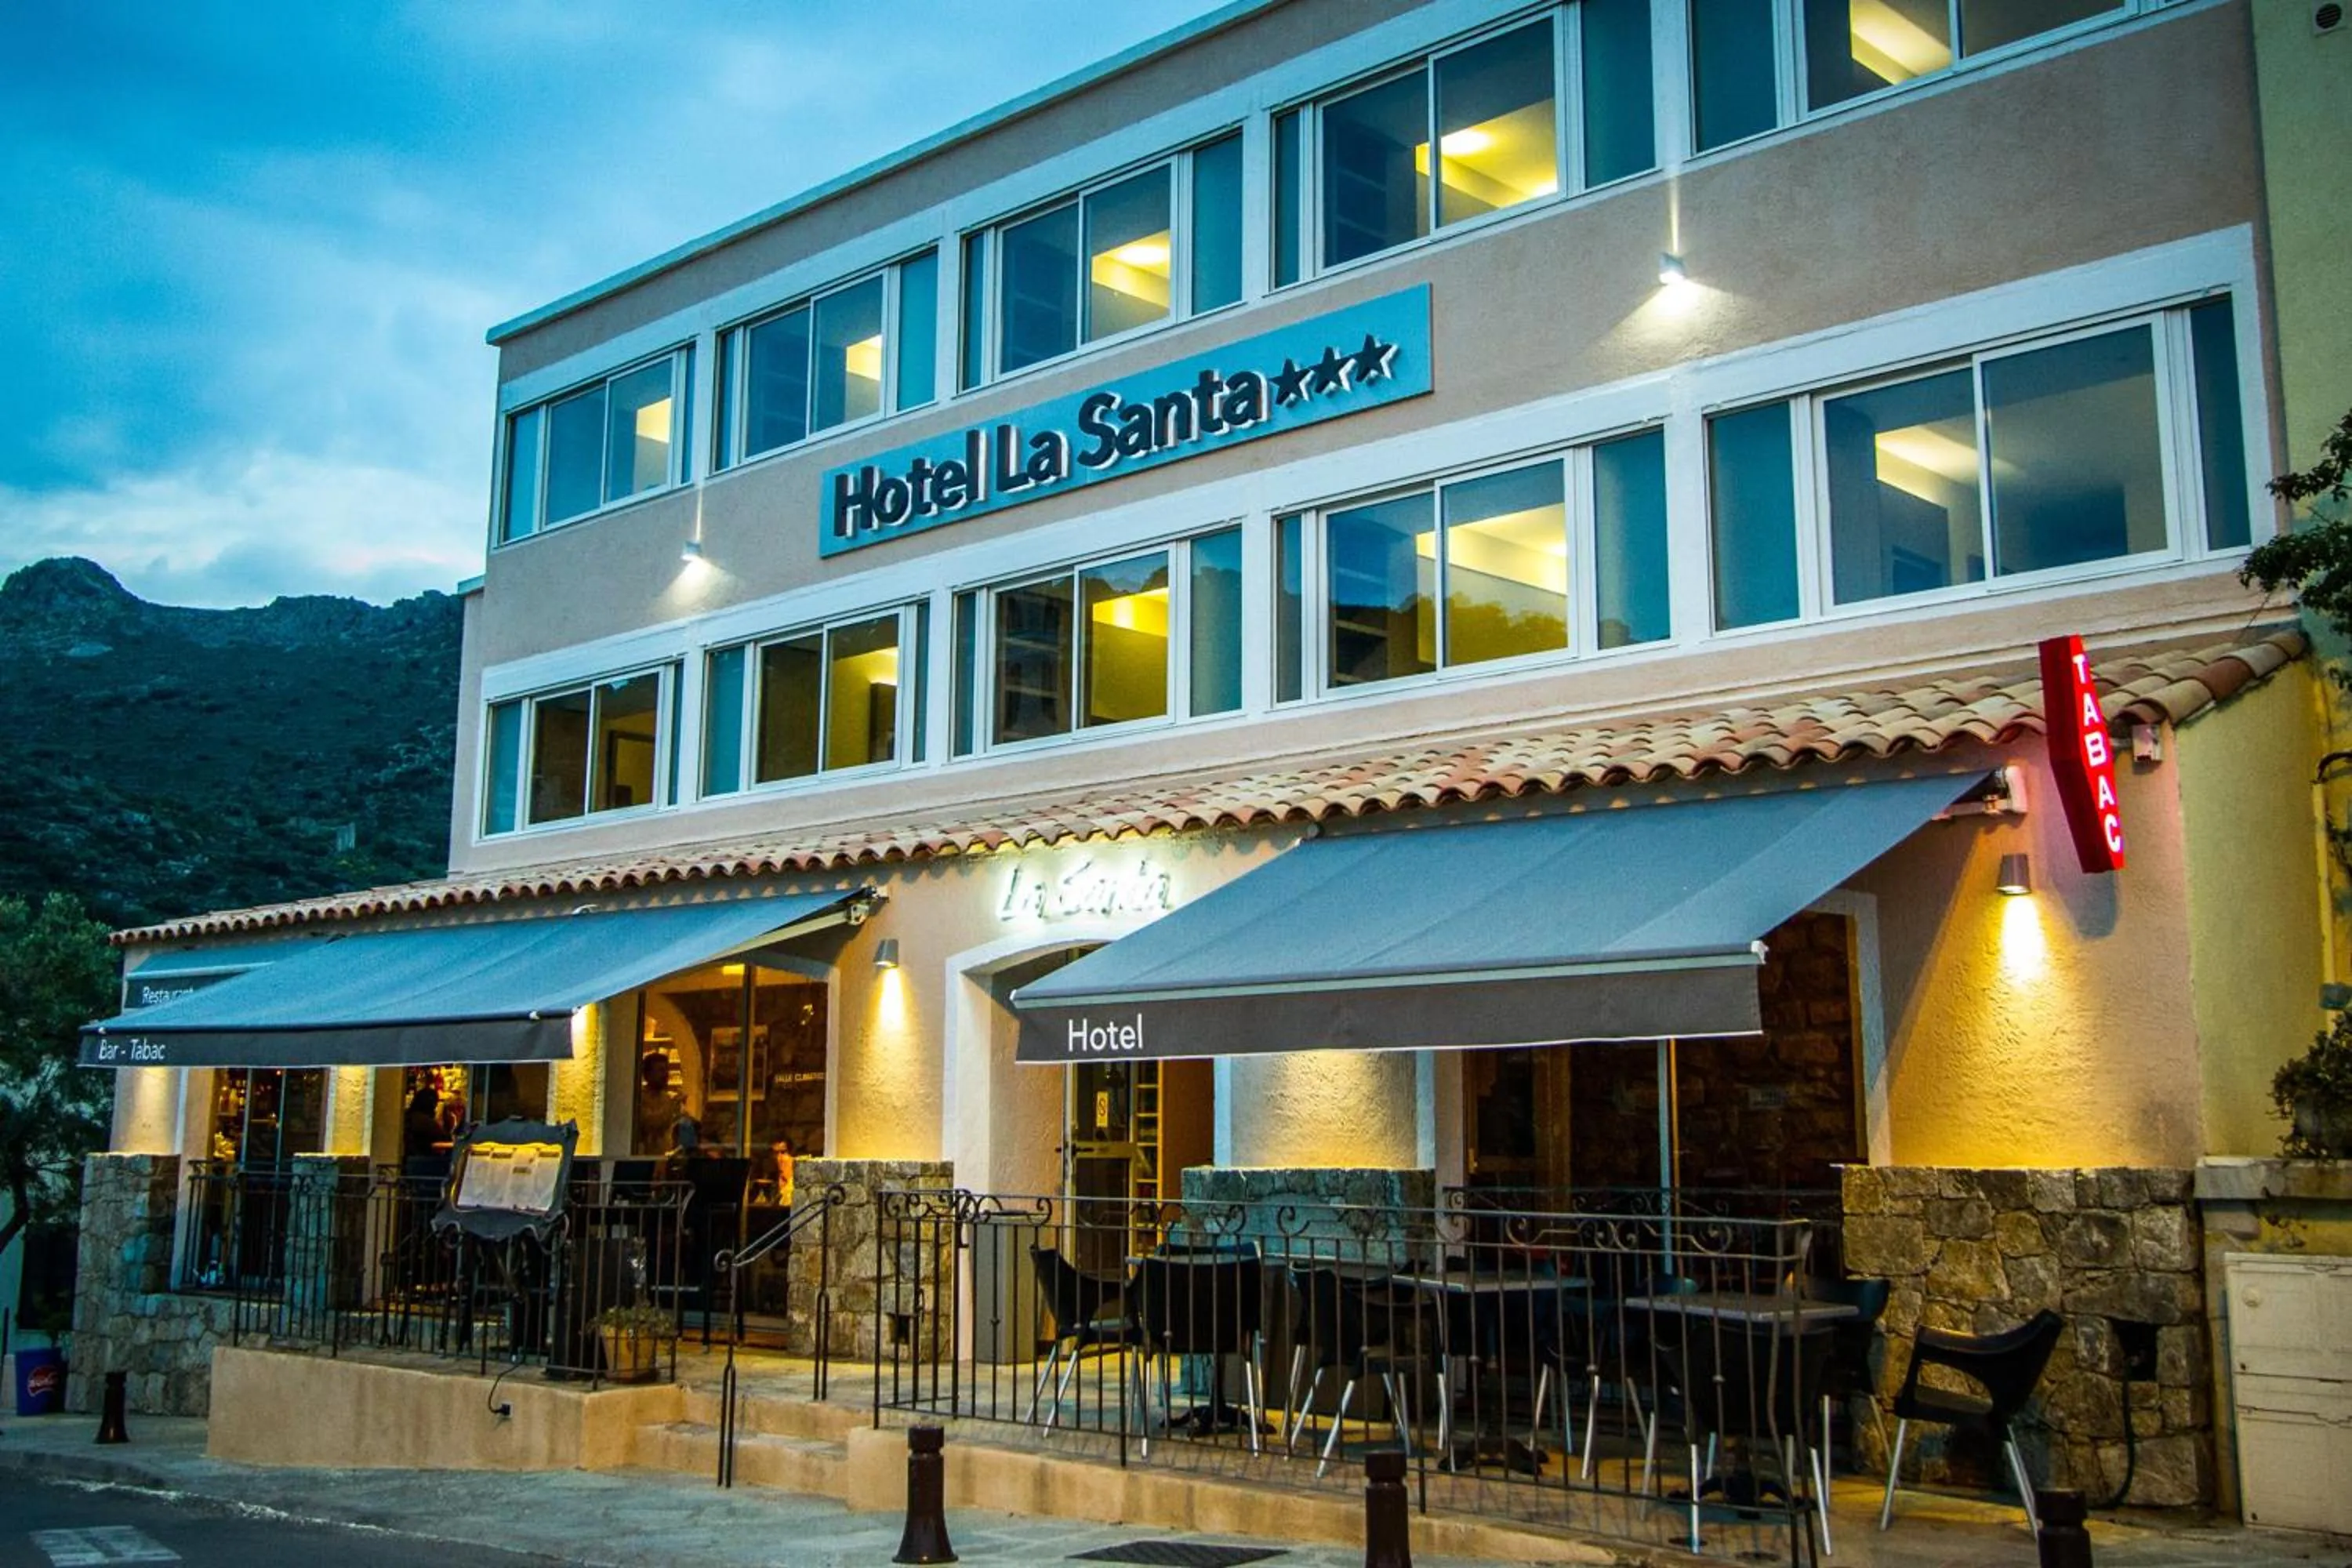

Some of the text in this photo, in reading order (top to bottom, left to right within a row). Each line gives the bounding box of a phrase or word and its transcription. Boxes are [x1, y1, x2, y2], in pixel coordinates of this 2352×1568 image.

[834, 369, 1268, 537] Hotel La Santa
[2072, 653, 2122, 852] TABAC
[99, 1039, 119, 1060] Bar
[130, 1037, 165, 1061] Tabac
[1069, 1013, 1143, 1051] Hotel
